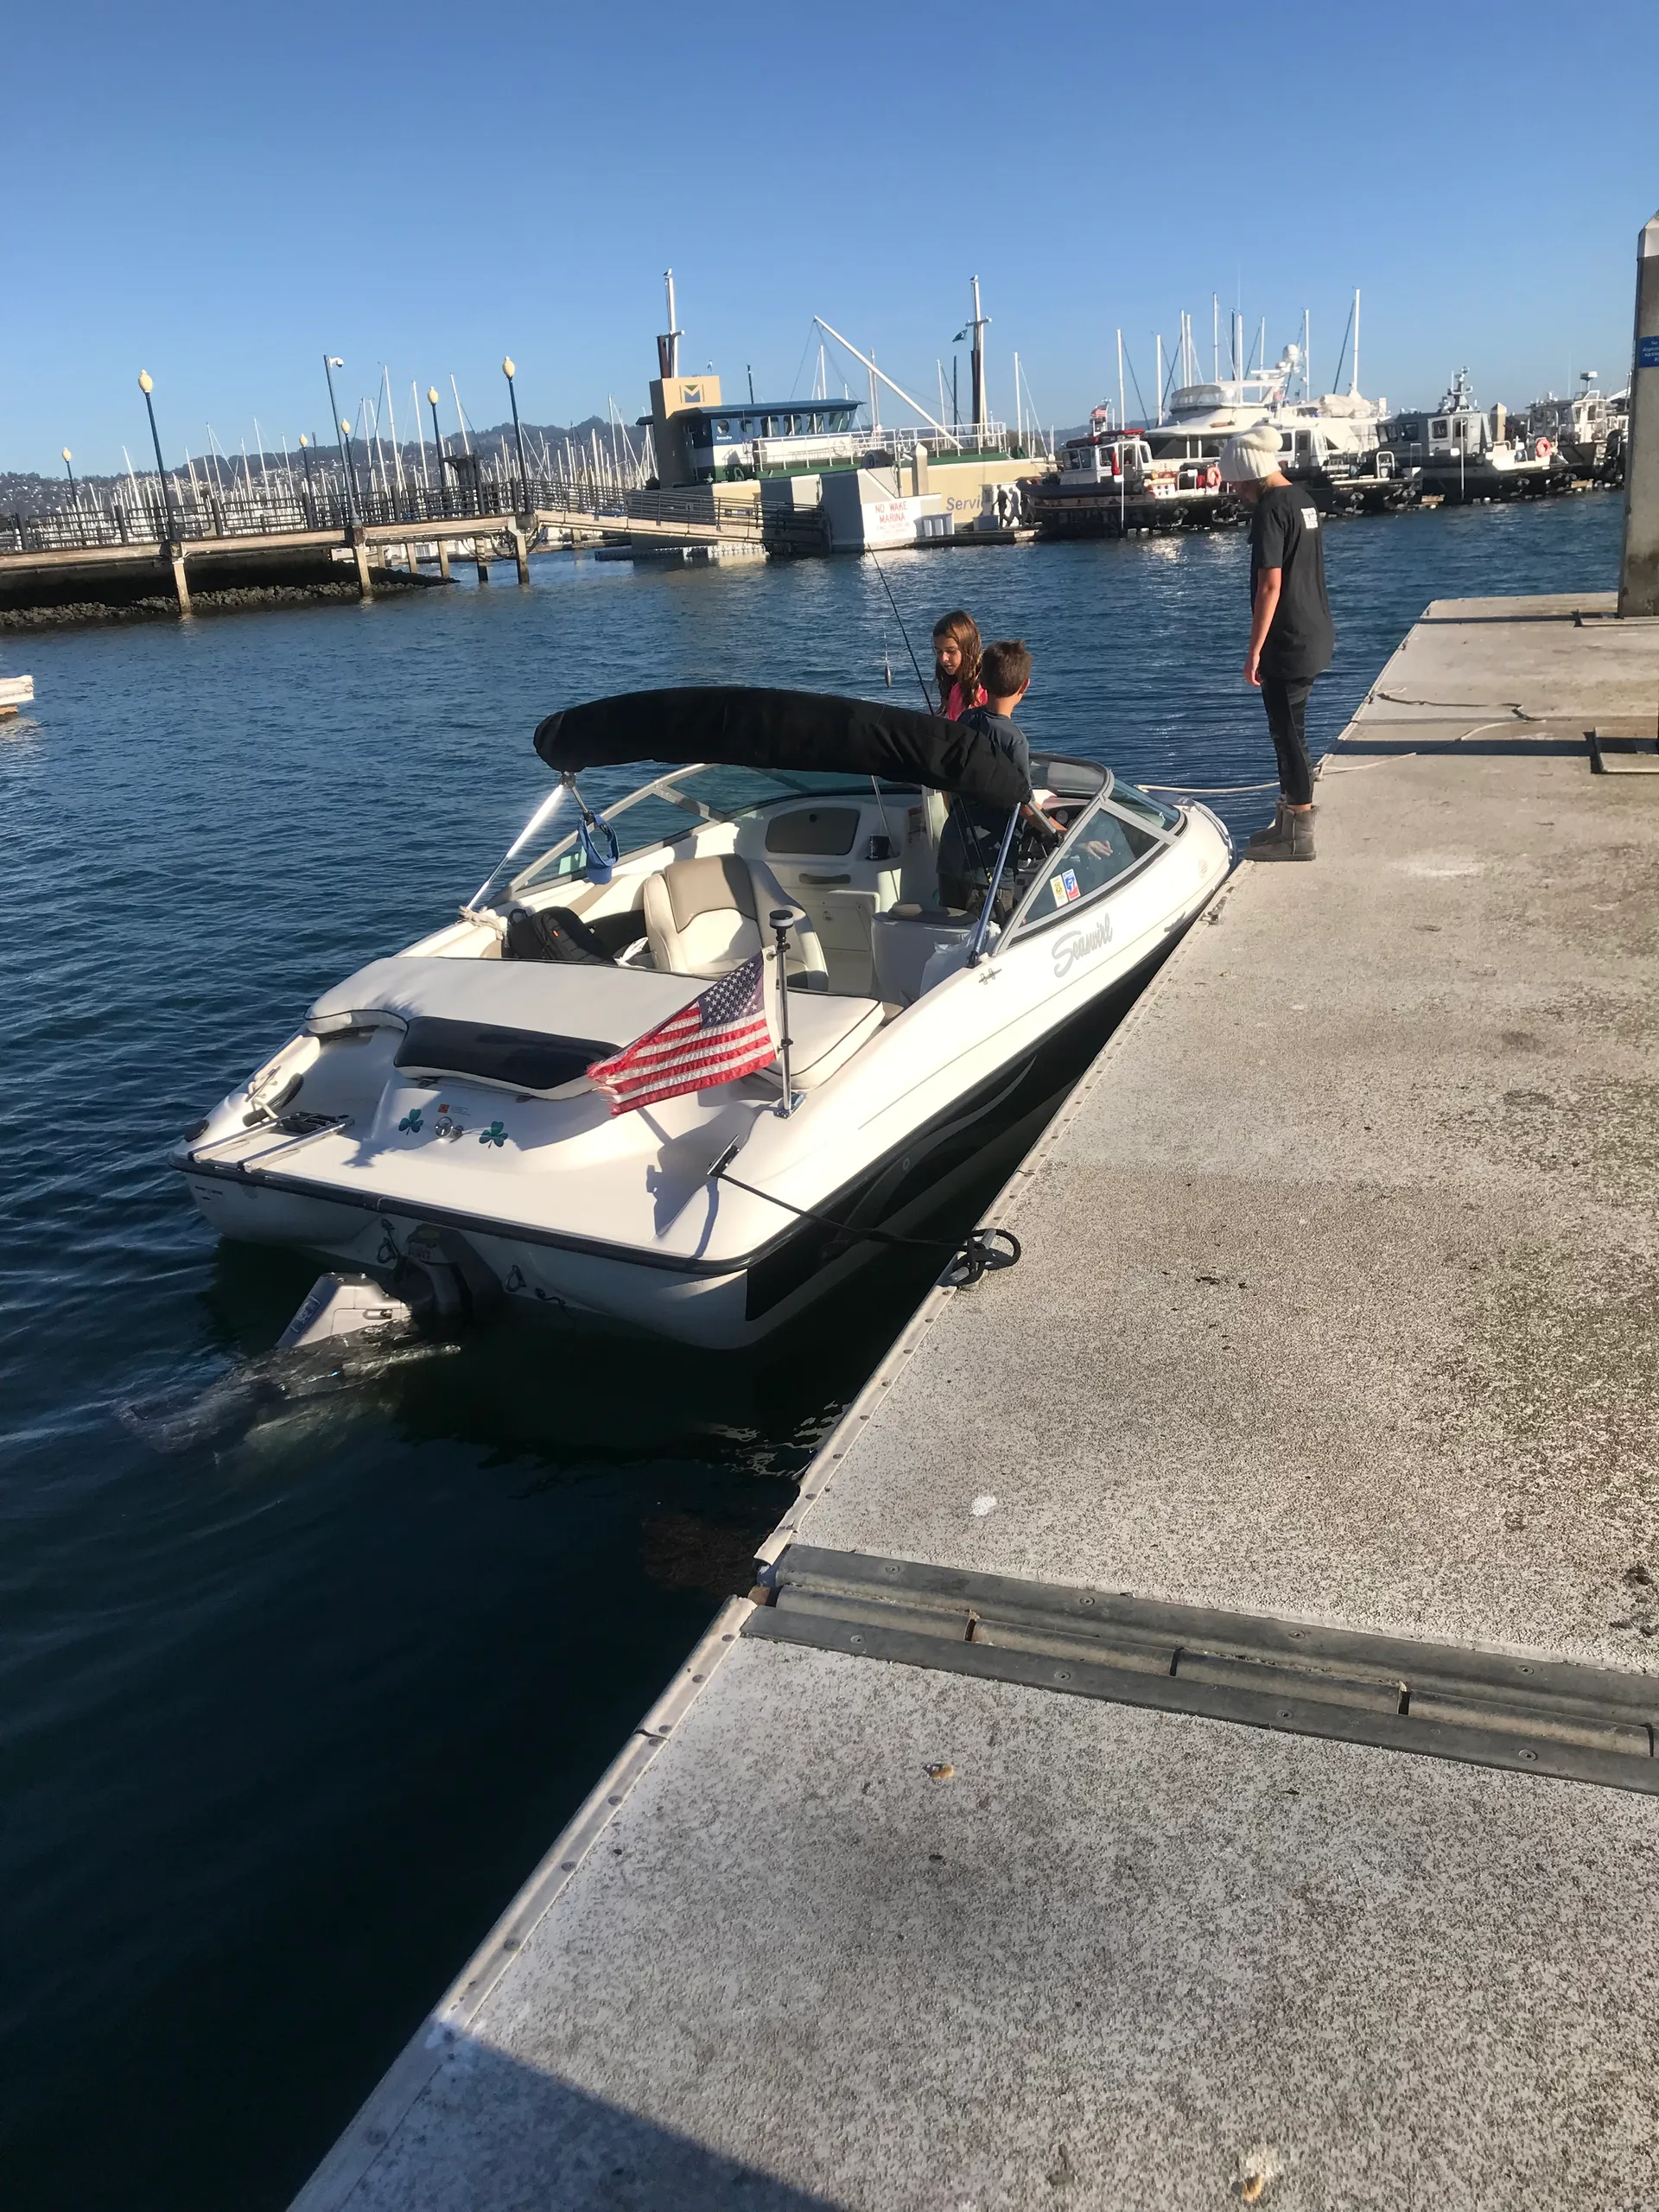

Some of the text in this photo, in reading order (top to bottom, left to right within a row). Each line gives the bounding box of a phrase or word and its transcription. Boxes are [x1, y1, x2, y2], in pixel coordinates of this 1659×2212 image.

[874, 501, 907, 513] NO WAKE
[946, 495, 983, 511] Servi
[880, 512, 905, 524] MARINA
